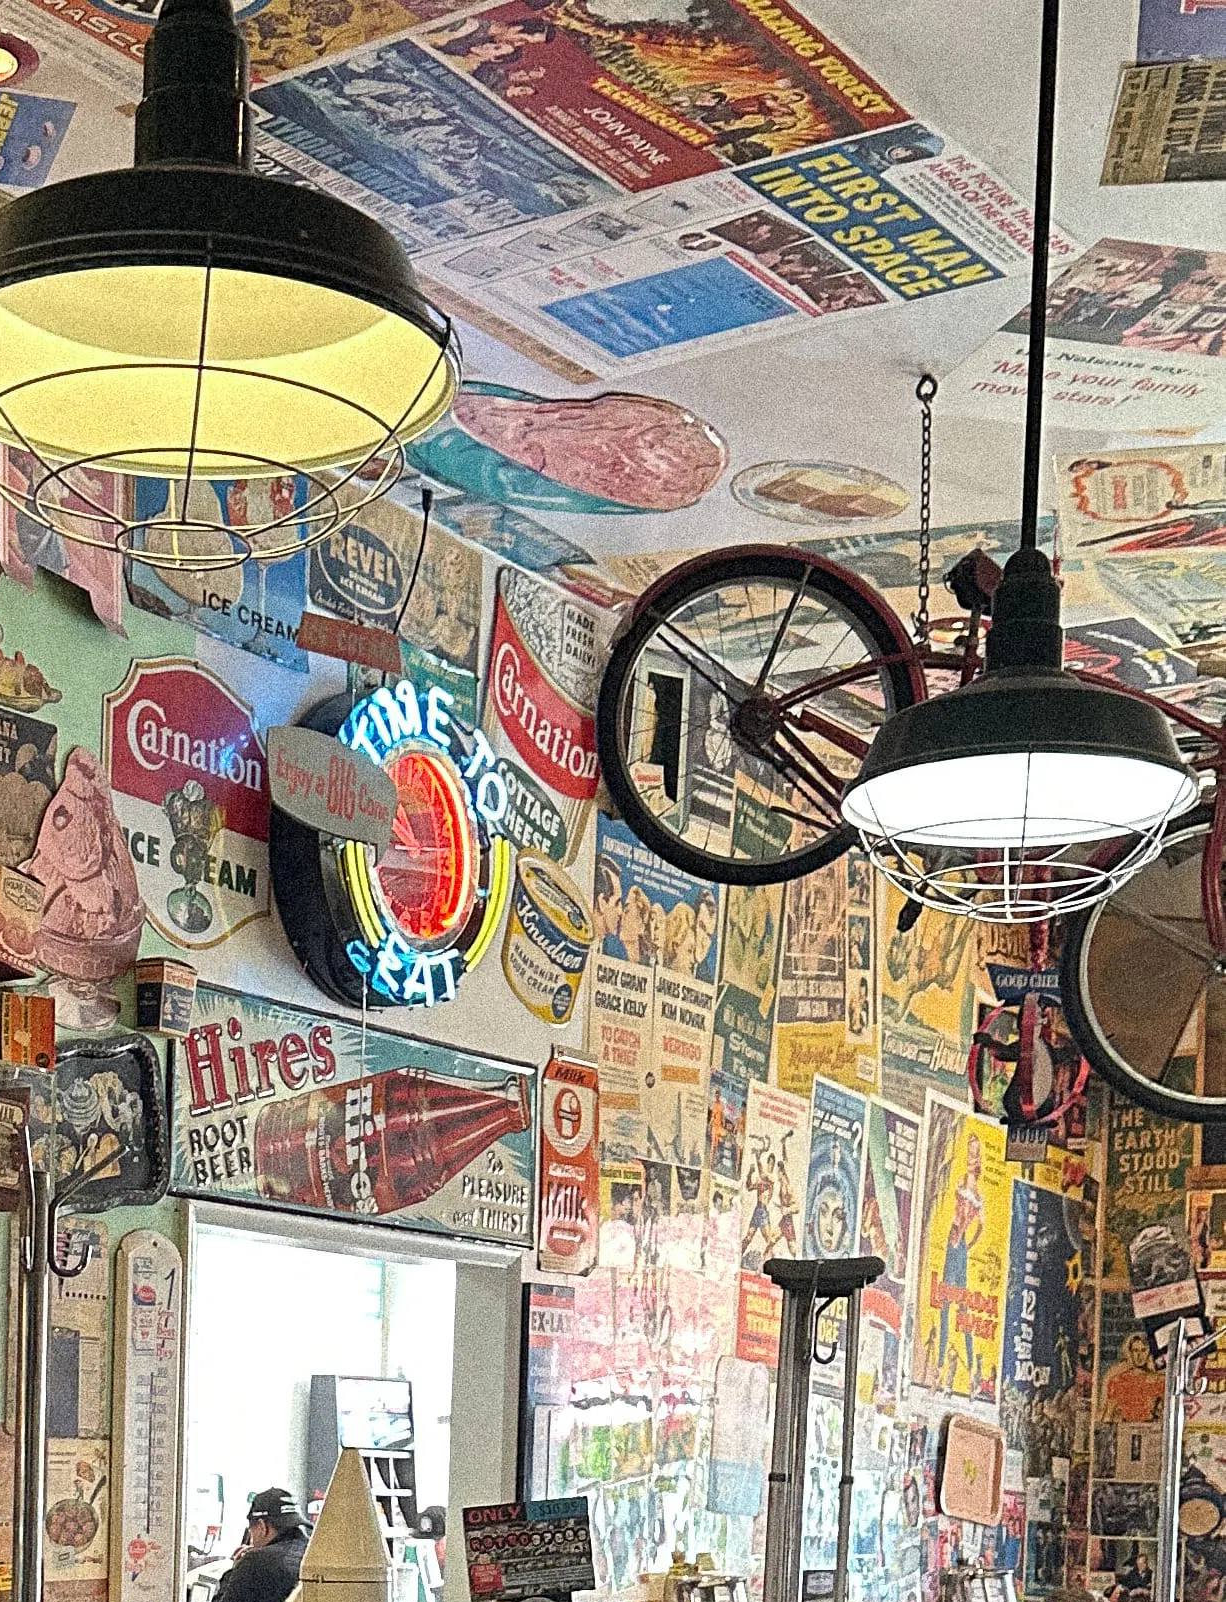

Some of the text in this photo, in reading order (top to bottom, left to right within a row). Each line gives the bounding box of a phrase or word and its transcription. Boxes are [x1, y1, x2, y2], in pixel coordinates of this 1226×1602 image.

[810, 54, 895, 115] FOREST
[591, 76, 714, 147] TECHNICOLOR
[583, 105, 629, 143] JOHN
[624, 131, 671, 167] PAYNE
[750, 165, 947, 297] INTO SPACE
[799, 152, 994, 286] FIRST MAN
[1069, 370, 1207, 398] your family
[329, 530, 398, 589] REVEL
[202, 589, 234, 616] ICE
[566, 606, 595, 633] MADE
[565, 624, 595, 648] FRESH
[350, 679, 456, 766] TIME
[494, 641, 599, 779] Carnation
[126, 698, 263, 793] Carnation
[463, 728, 509, 822] TO
[497, 760, 561, 838] COTTAGE
[516, 895, 584, 968] Knudsen
[378, 930, 460, 1008] EAT
[514, 942, 561, 985] HAMPSHIRE
[596, 963, 648, 994] CARY GRANT
[594, 988, 648, 1019] GRACE KELLY
[655, 974, 713, 1011] JAMES STEWART
[660, 1000, 707, 1032] KIM NOVAK
[601, 1023, 641, 1050] TO CATCH
[661, 1034, 703, 1063] VERTIGO
[181, 1016, 337, 1117] Hires
[611, 1046, 639, 1067] THIEF
[189, 1115, 249, 1158] ROOT
[1112, 1108, 1144, 1128] THE
[1113, 1128, 1178, 1151] EARTH
[193, 1146, 252, 1188] BEER
[1118, 1150, 1182, 1173] STOOD
[462, 1174, 529, 1207] PLEASURE
[545, 1181, 589, 1224] Milk
[1124, 1173, 1176, 1195] STILL
[474, 1206, 529, 1234] THIRST
[468, 1505, 522, 1525] ONLY
